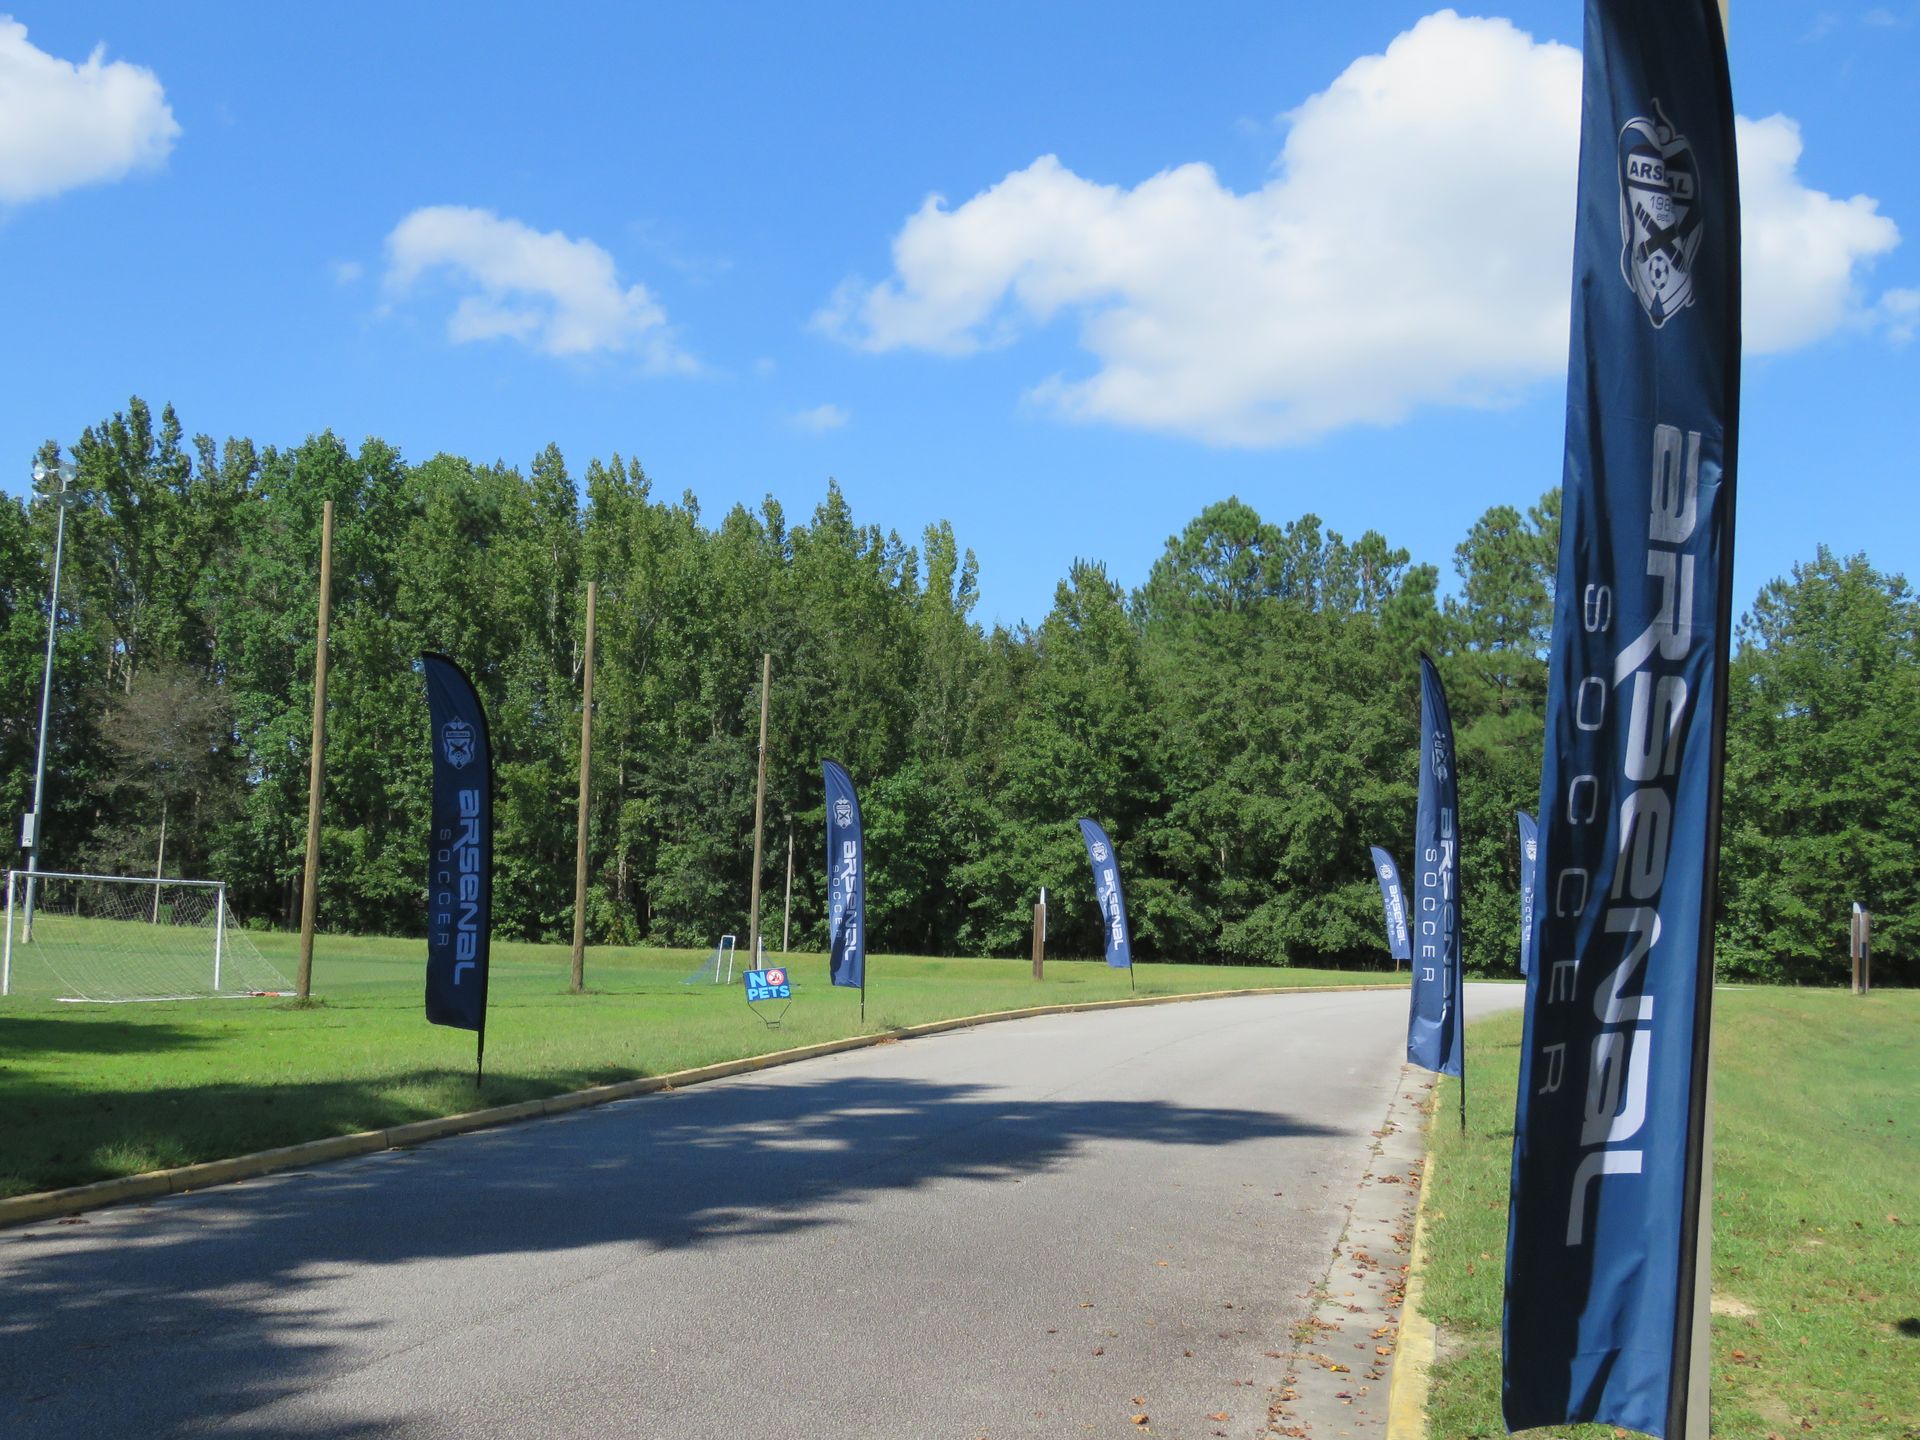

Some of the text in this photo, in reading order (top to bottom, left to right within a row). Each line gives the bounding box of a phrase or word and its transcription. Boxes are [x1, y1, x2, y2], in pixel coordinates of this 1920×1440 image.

[1629, 160, 1690, 195] ARSAL
[438, 828, 451, 946] SOCCER
[1538, 583, 1612, 1096] SOCCER
[1422, 848, 1437, 982] SOCCER
[748, 986, 790, 1000] PETS
